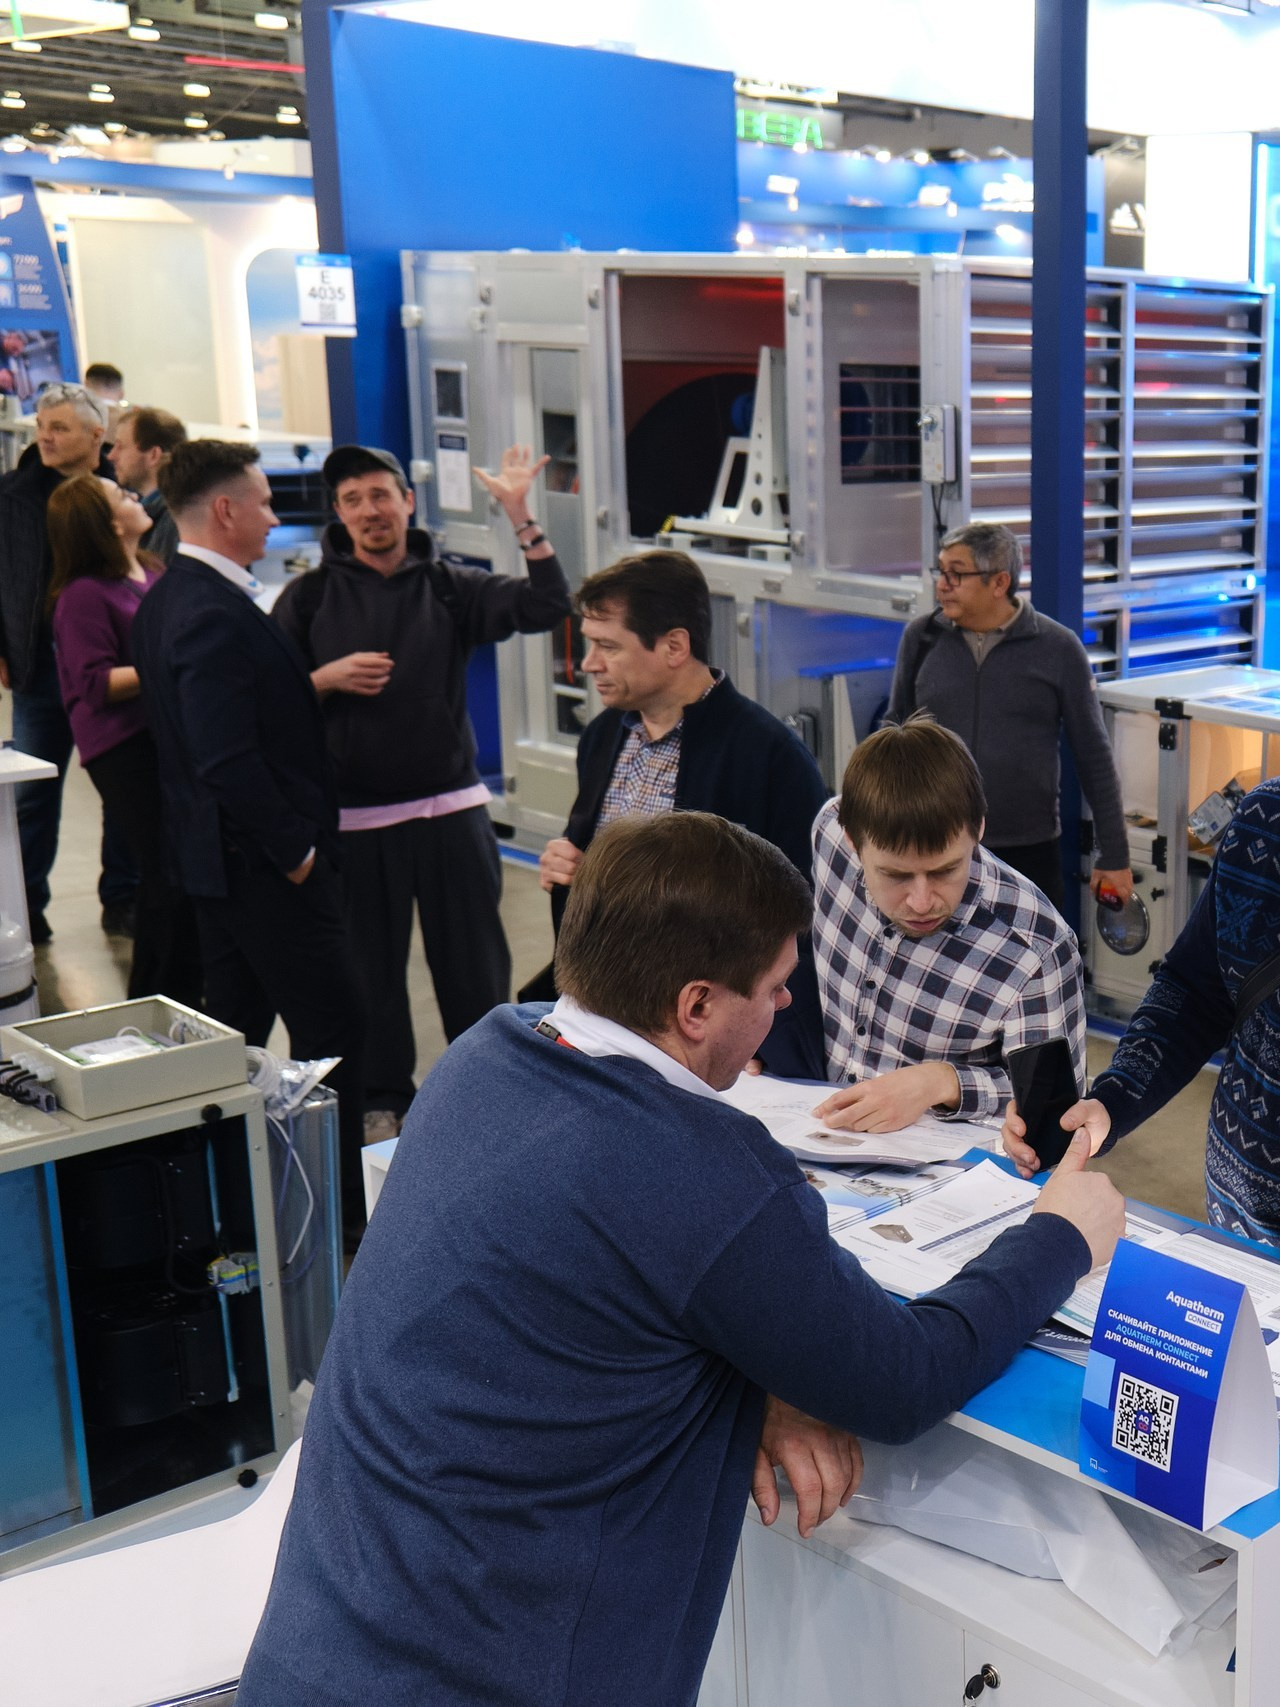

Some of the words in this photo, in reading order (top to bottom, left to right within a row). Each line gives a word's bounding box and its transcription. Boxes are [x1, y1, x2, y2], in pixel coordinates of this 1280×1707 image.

[307, 286, 346, 301] 4035
[1166, 1291, 1225, 1321] Aquatherm
[1107, 1308, 1158, 1335] СКАЧИВАЙТЕ
[1157, 1328, 1214, 1357] ПРИЛОЖЕНИЕ
[1187, 1313, 1220, 1331] CONNECT
[1104, 1330, 1122, 1343] ДЛЯ
[1122, 1336, 1154, 1357] ОБМЕНА
[1155, 1348, 1209, 1379] КОНТАКТАМИ
[1115, 1323, 1162, 1348] AQUATHERM
[1163, 1342, 1200, 1363] CONNECT
[1138, 1414, 1149, 1425] AQ
